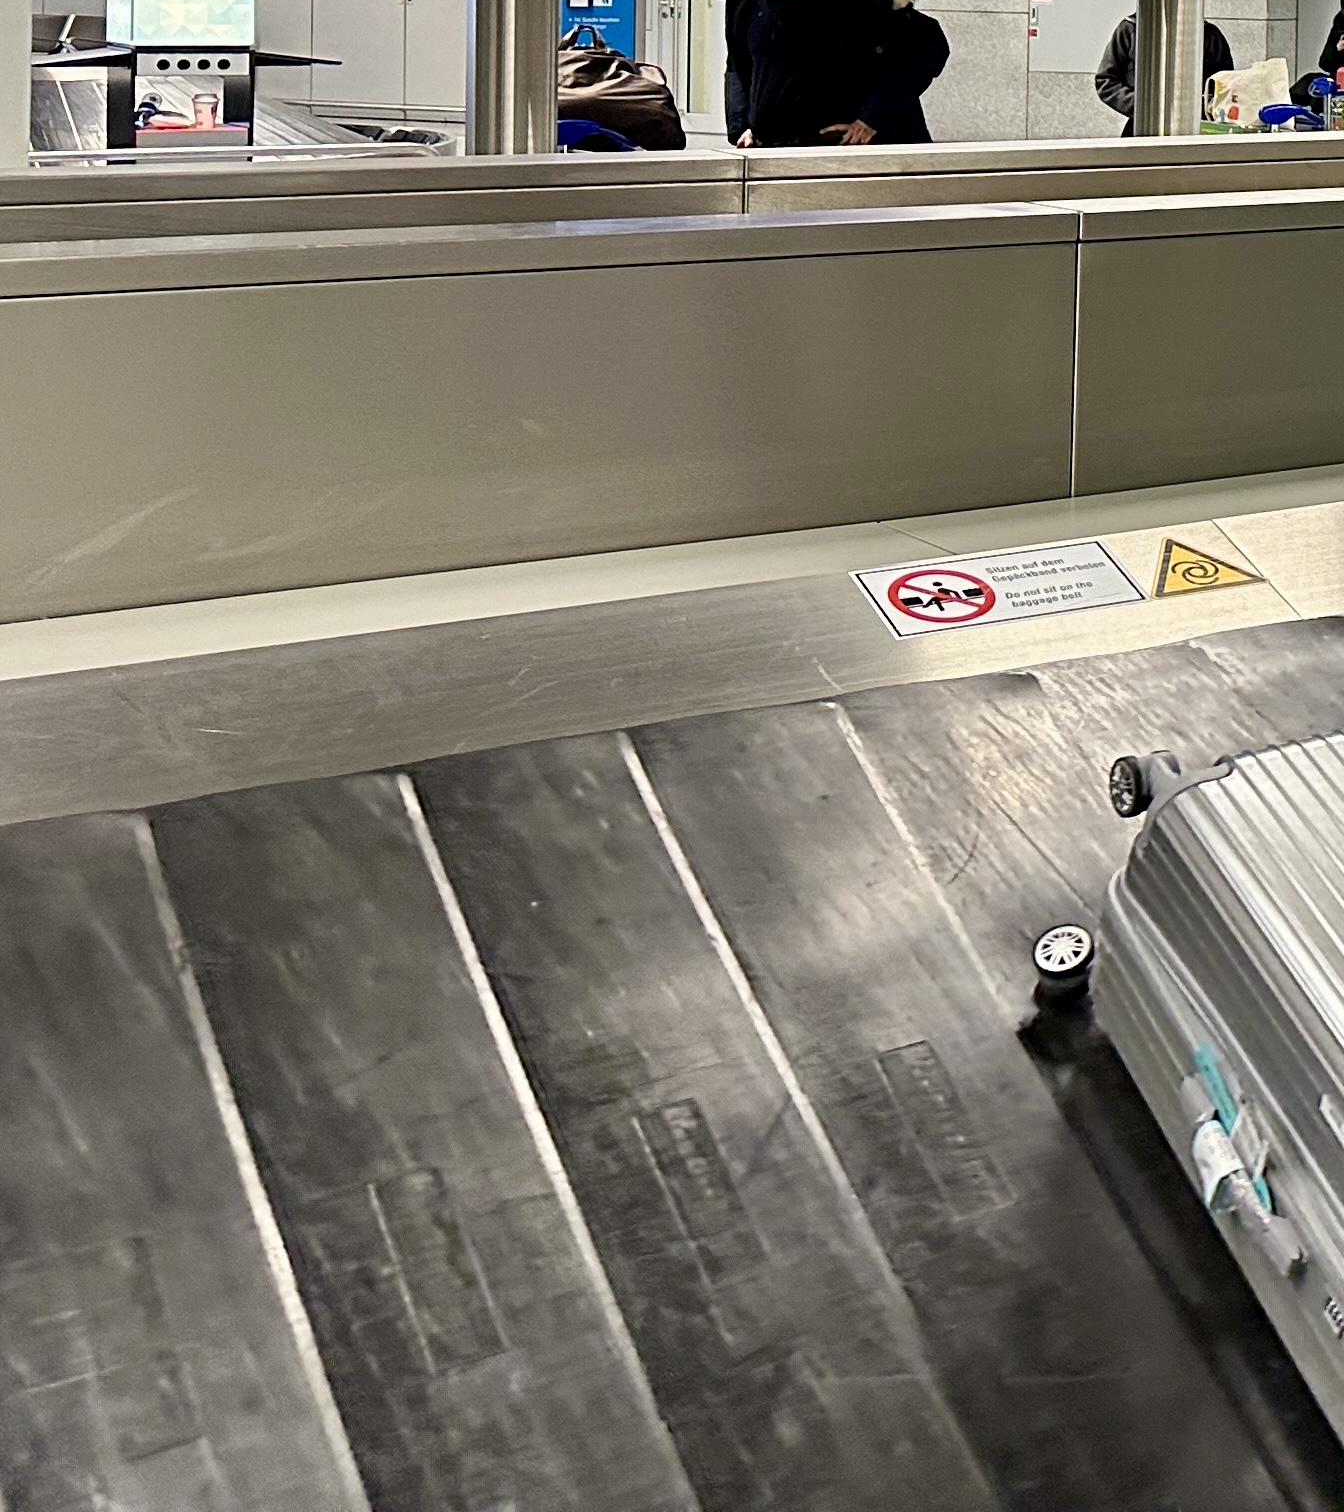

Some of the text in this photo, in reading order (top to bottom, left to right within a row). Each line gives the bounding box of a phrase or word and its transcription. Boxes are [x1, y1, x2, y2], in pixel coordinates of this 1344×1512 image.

[985, 558, 1065, 575] Sitzen auf dem
[991, 561, 1107, 583] Gepäckband verboten
[1005, 581, 1094, 600] Do not sit on the
[1011, 591, 1082, 608] baggage belt
